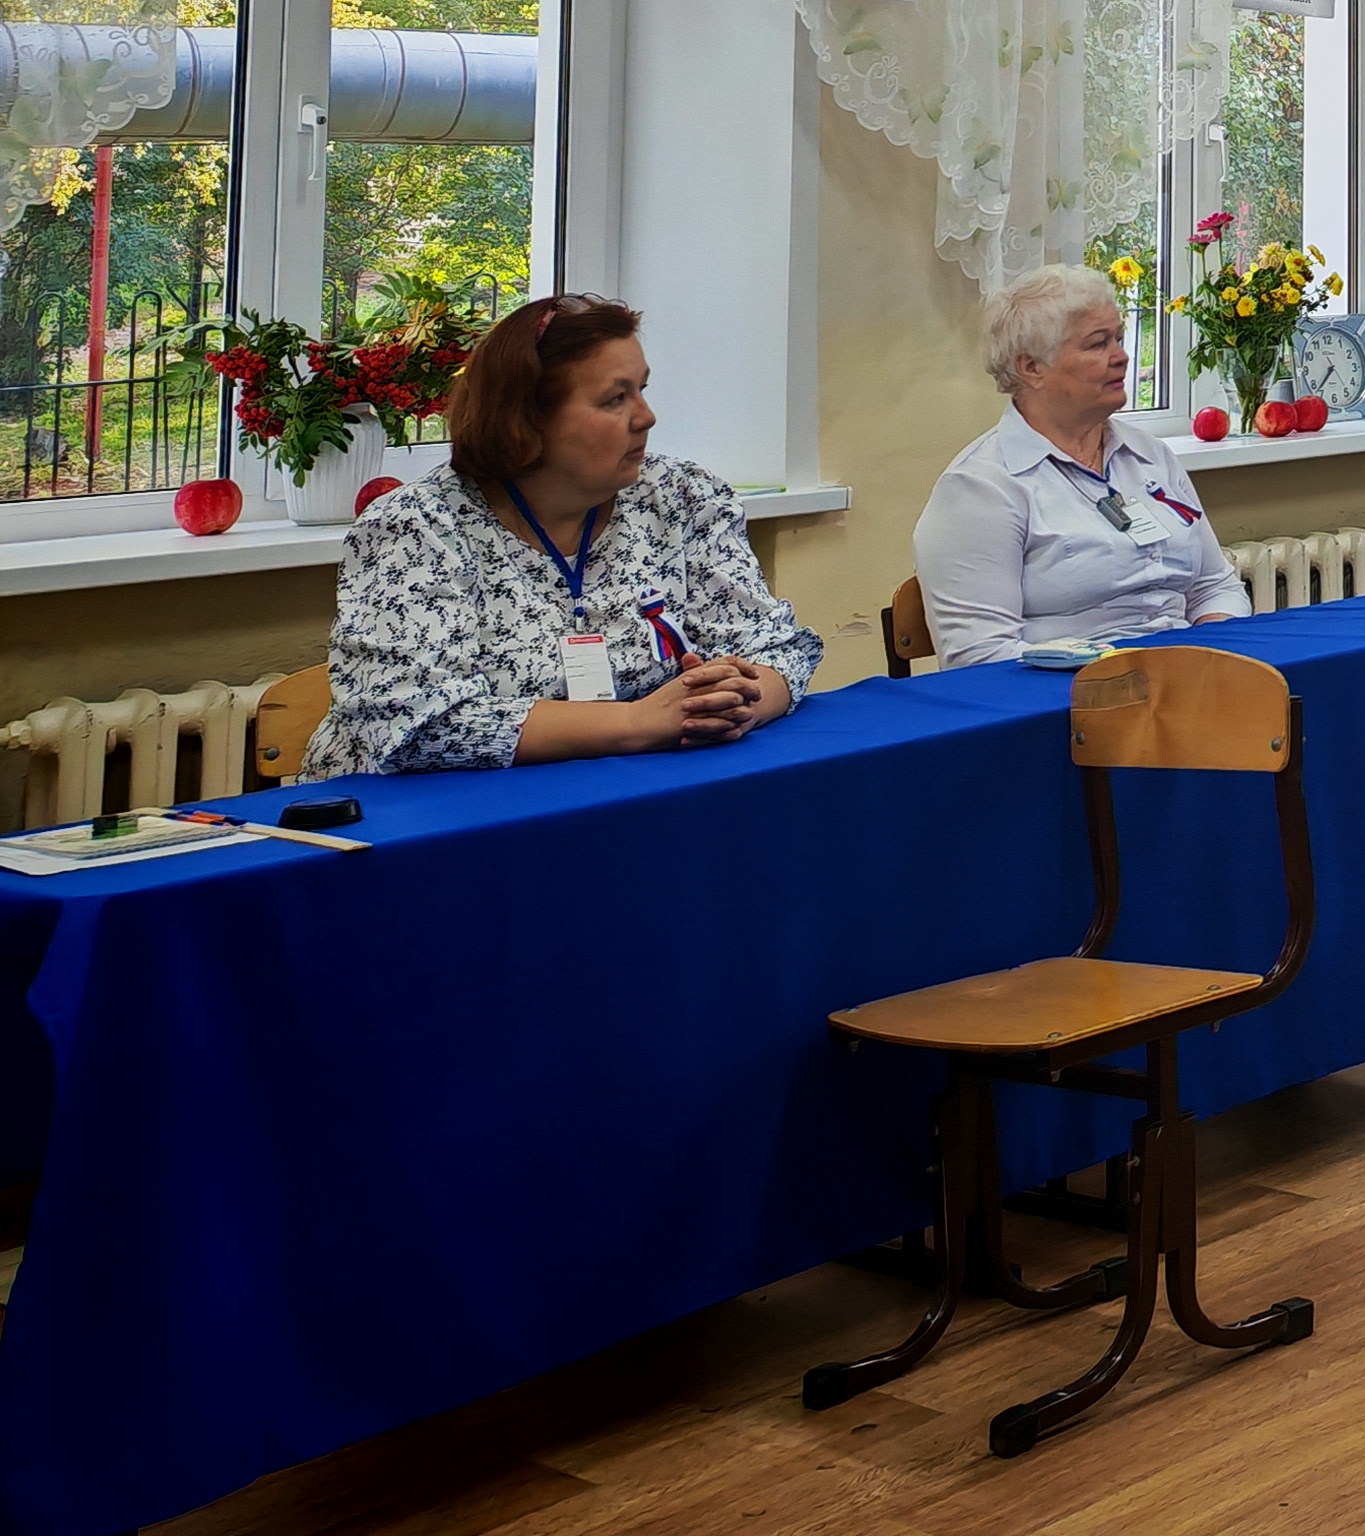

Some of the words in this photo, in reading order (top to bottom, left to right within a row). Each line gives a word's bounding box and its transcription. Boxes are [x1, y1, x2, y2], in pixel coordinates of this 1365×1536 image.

[1322, 335, 1332, 345] 12
[1312, 341, 1320, 350] 11
[1305, 351, 1314, 362] 10
[1346, 349, 1352, 359] 2
[1303, 365, 1309, 376] 9
[1352, 363, 1358, 372] 3
[1311, 379, 1317, 390] 8
[1350, 377, 1356, 387] 4
[1343, 387, 1349, 398] 5
[1331, 393, 1338, 404] 6
